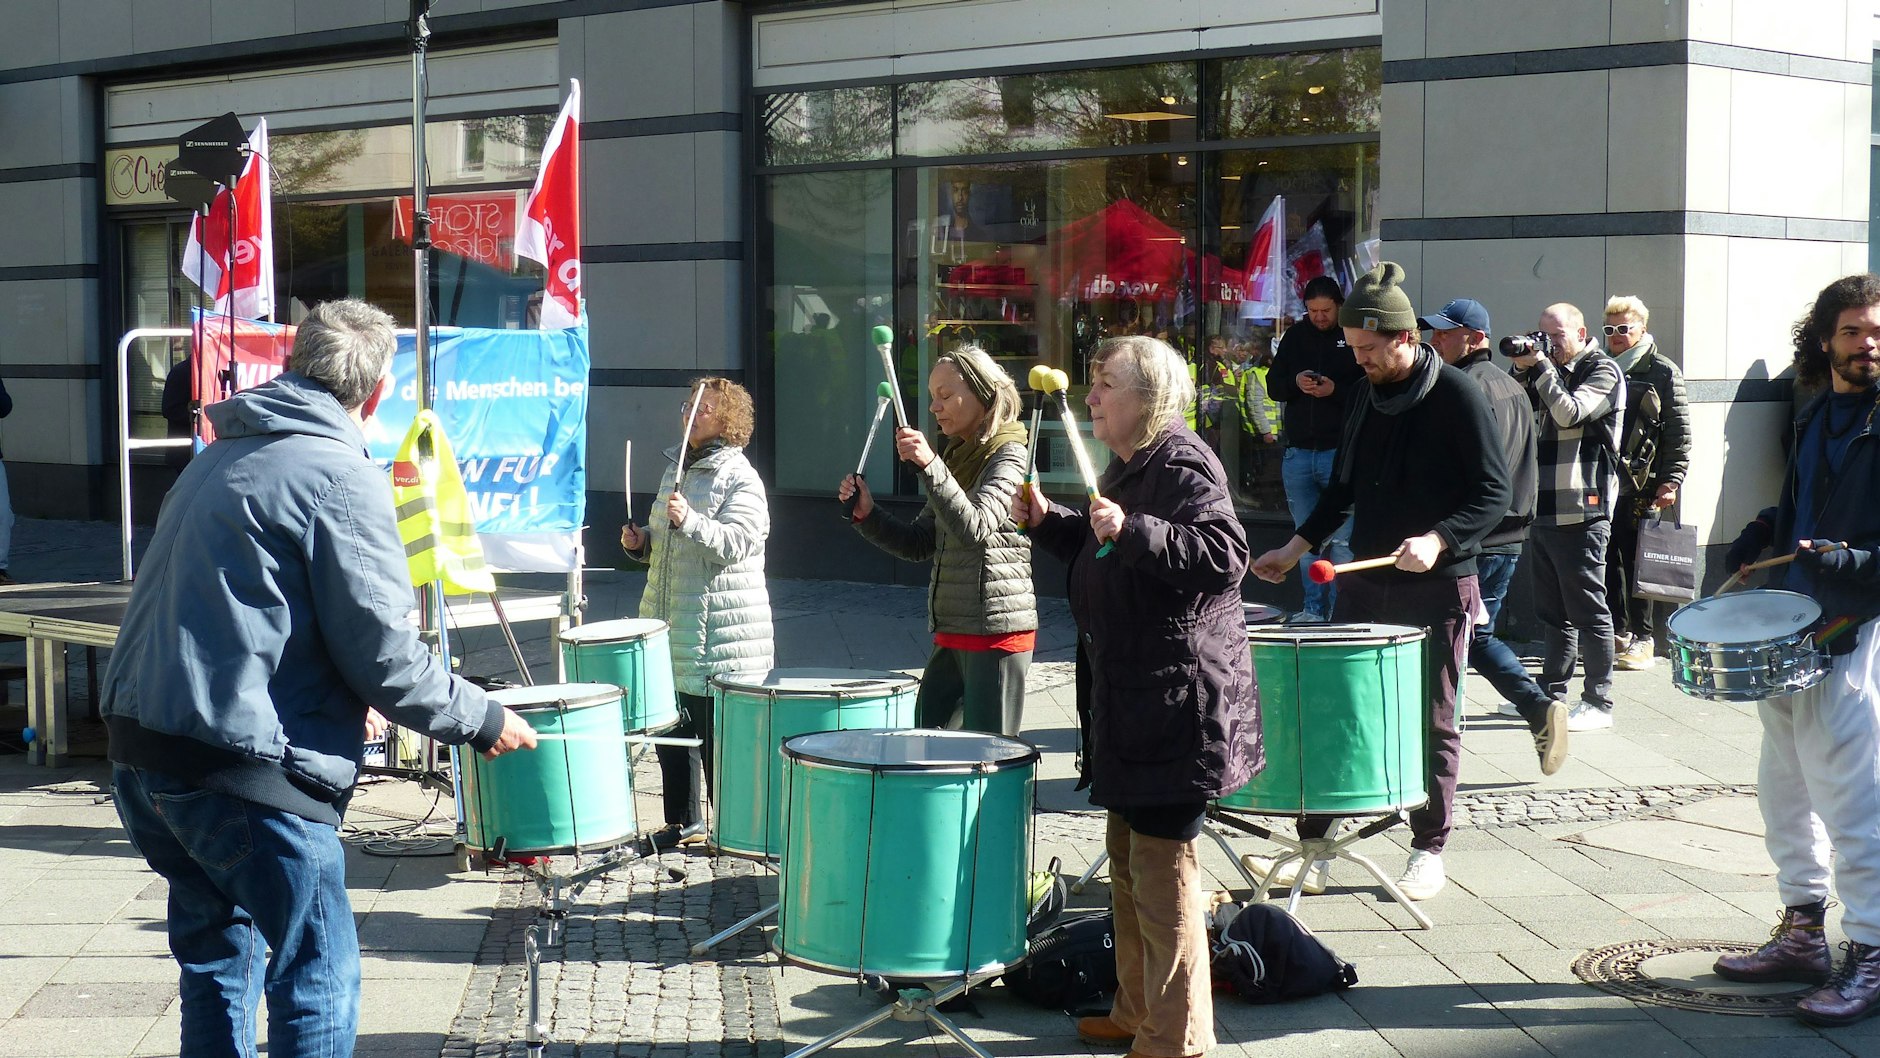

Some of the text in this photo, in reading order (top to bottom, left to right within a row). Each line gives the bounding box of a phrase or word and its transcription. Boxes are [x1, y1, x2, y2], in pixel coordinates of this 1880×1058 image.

[134, 156, 166, 194] Crê
[446, 377, 548, 400] Menschen
[394, 476, 419, 484] ver.di
[1643, 552, 1670, 560] LEITNER
[1670, 555, 1693, 564] LEINEN
